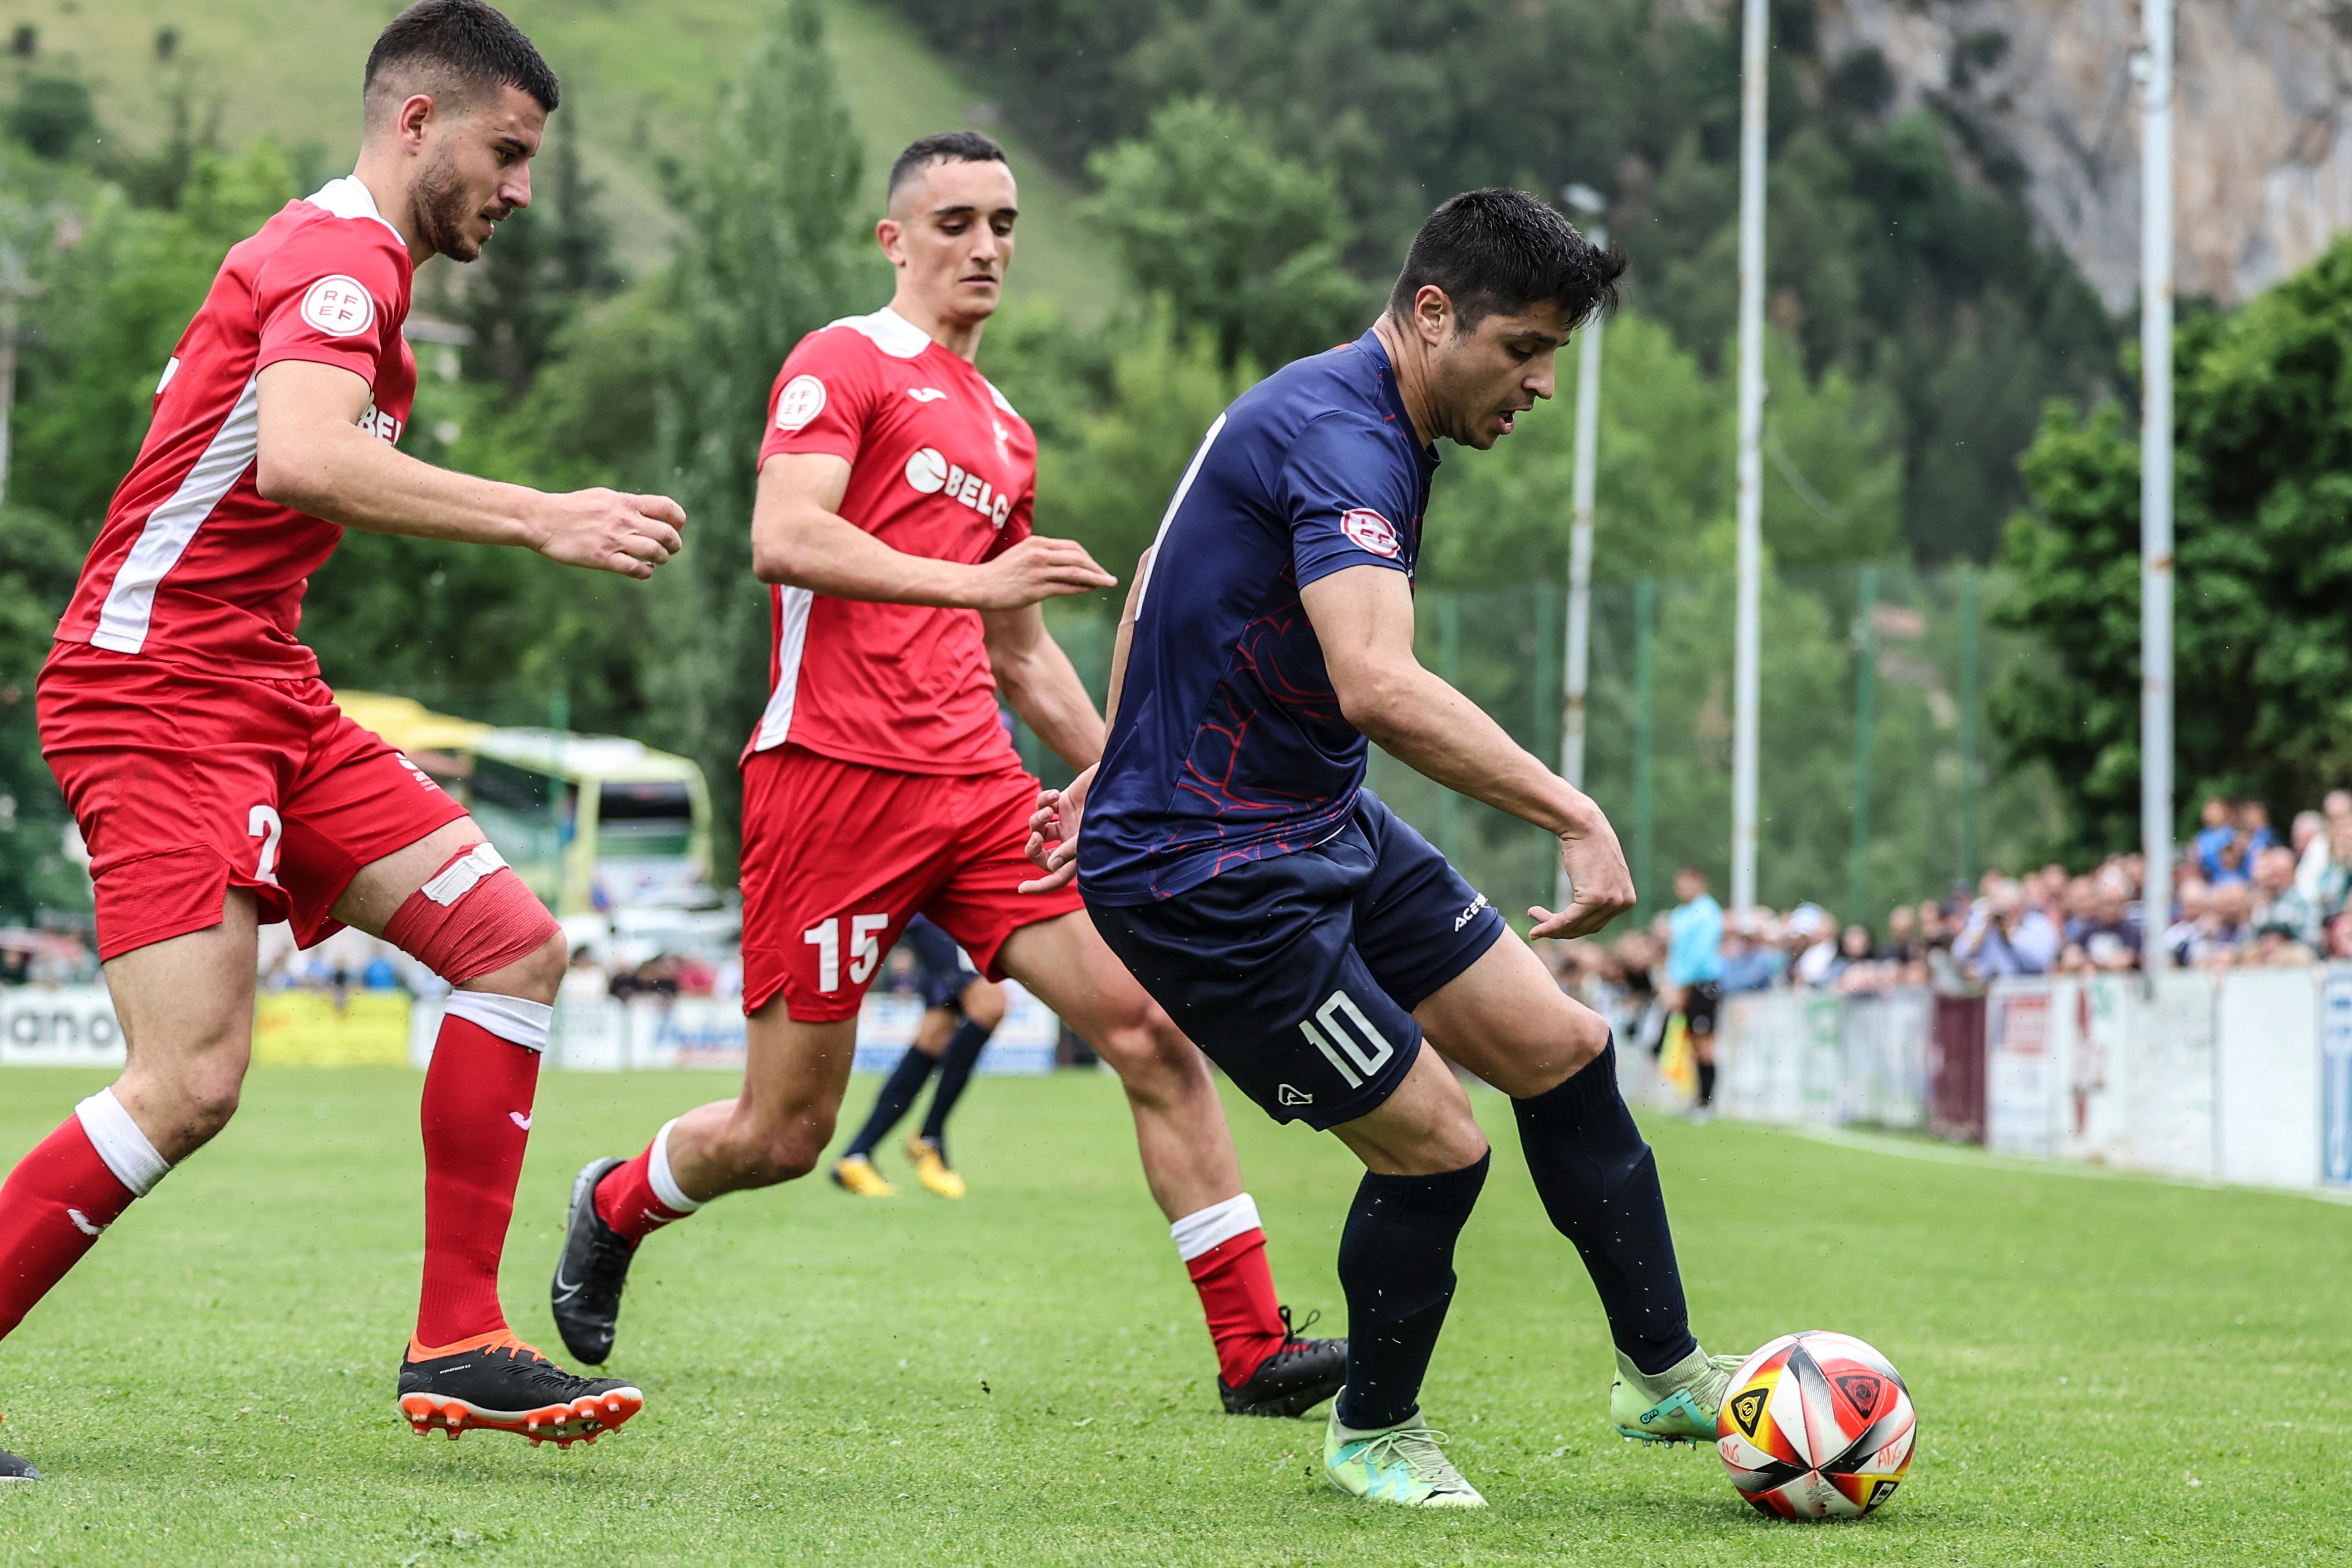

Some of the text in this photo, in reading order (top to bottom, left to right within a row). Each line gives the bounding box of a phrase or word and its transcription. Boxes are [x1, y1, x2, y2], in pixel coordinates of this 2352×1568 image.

[248, 805, 282, 885] 2
[804, 913, 889, 993] 15
[1298, 989, 1394, 1089] 10
